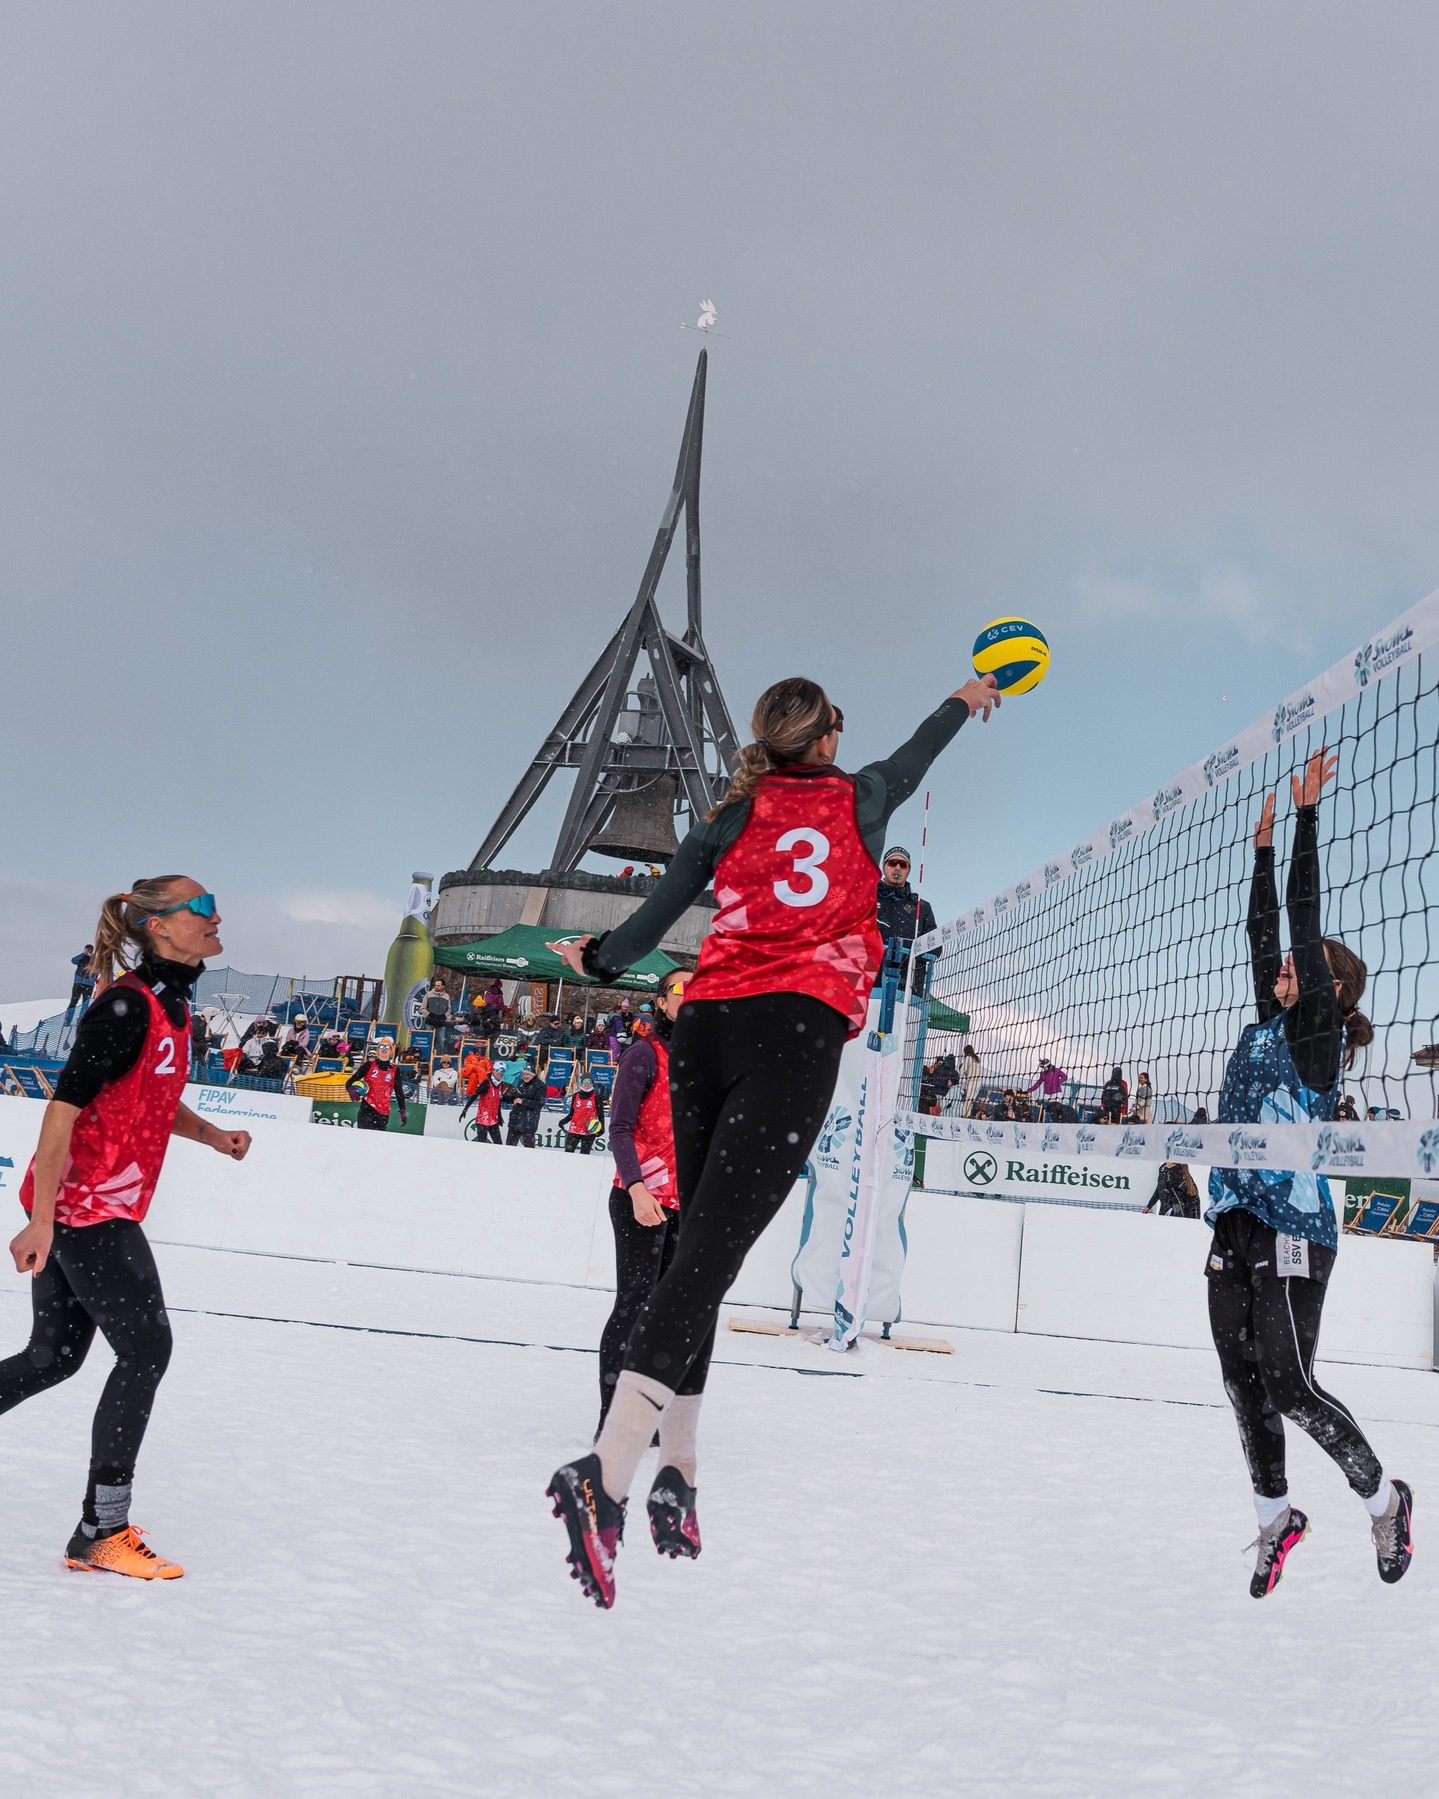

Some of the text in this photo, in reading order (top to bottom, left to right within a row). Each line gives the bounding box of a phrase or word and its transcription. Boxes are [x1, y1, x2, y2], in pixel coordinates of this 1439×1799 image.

[1001, 625, 1023, 633] CEV
[1372, 640, 1412, 672] VOLLEYBALL
[773, 827, 830, 907] 3
[154, 1036, 176, 1074] 2
[371, 1069, 379, 1078] 2
[198, 1089, 237, 1104] FIPAV
[576, 1100, 581, 1108] 3
[841, 1077, 867, 1258] VOLLEYBALL
[1005, 1160, 1131, 1190] Raiffeisen
[1291, 1244, 1302, 1265] SSV
